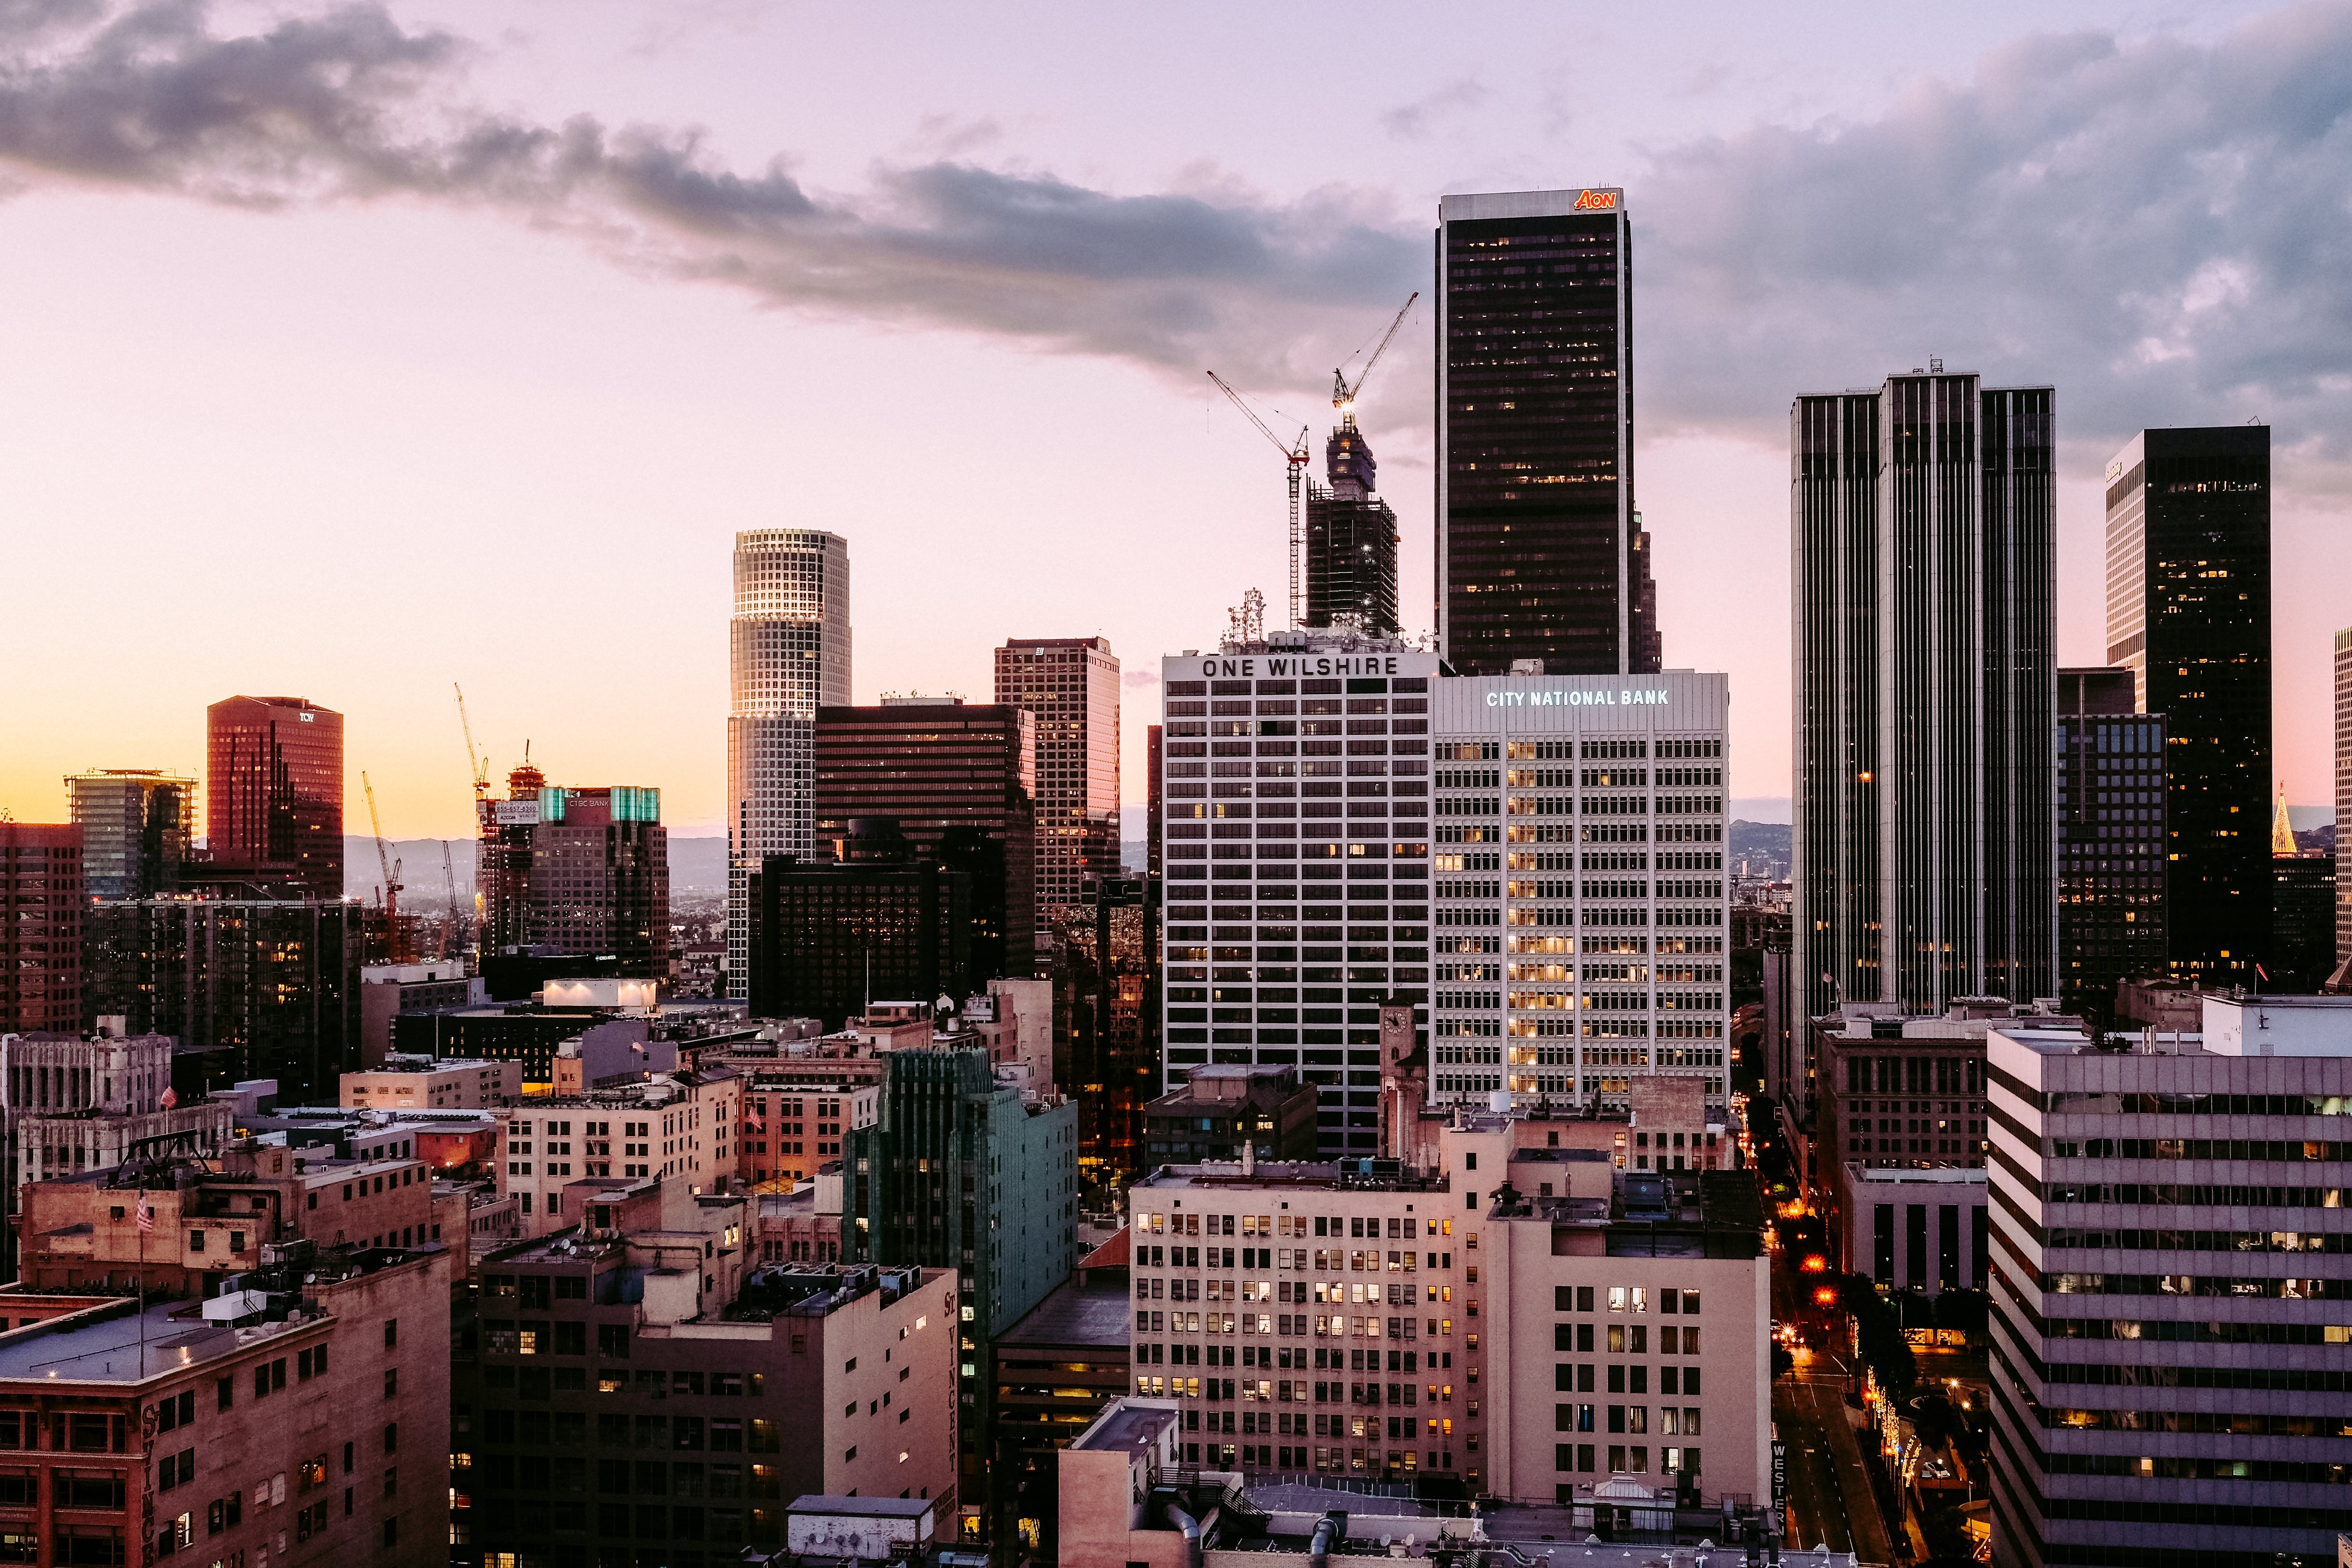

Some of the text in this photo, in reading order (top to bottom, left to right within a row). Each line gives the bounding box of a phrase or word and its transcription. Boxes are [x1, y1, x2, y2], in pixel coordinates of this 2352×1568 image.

[1203, 657, 1397, 677] ONE WILSHIRE
[1486, 690, 1668, 707] CITY NATIONAL BANK
[299, 712, 314, 723] TCW
[1774, 1446, 1785, 1536] WESTERN
